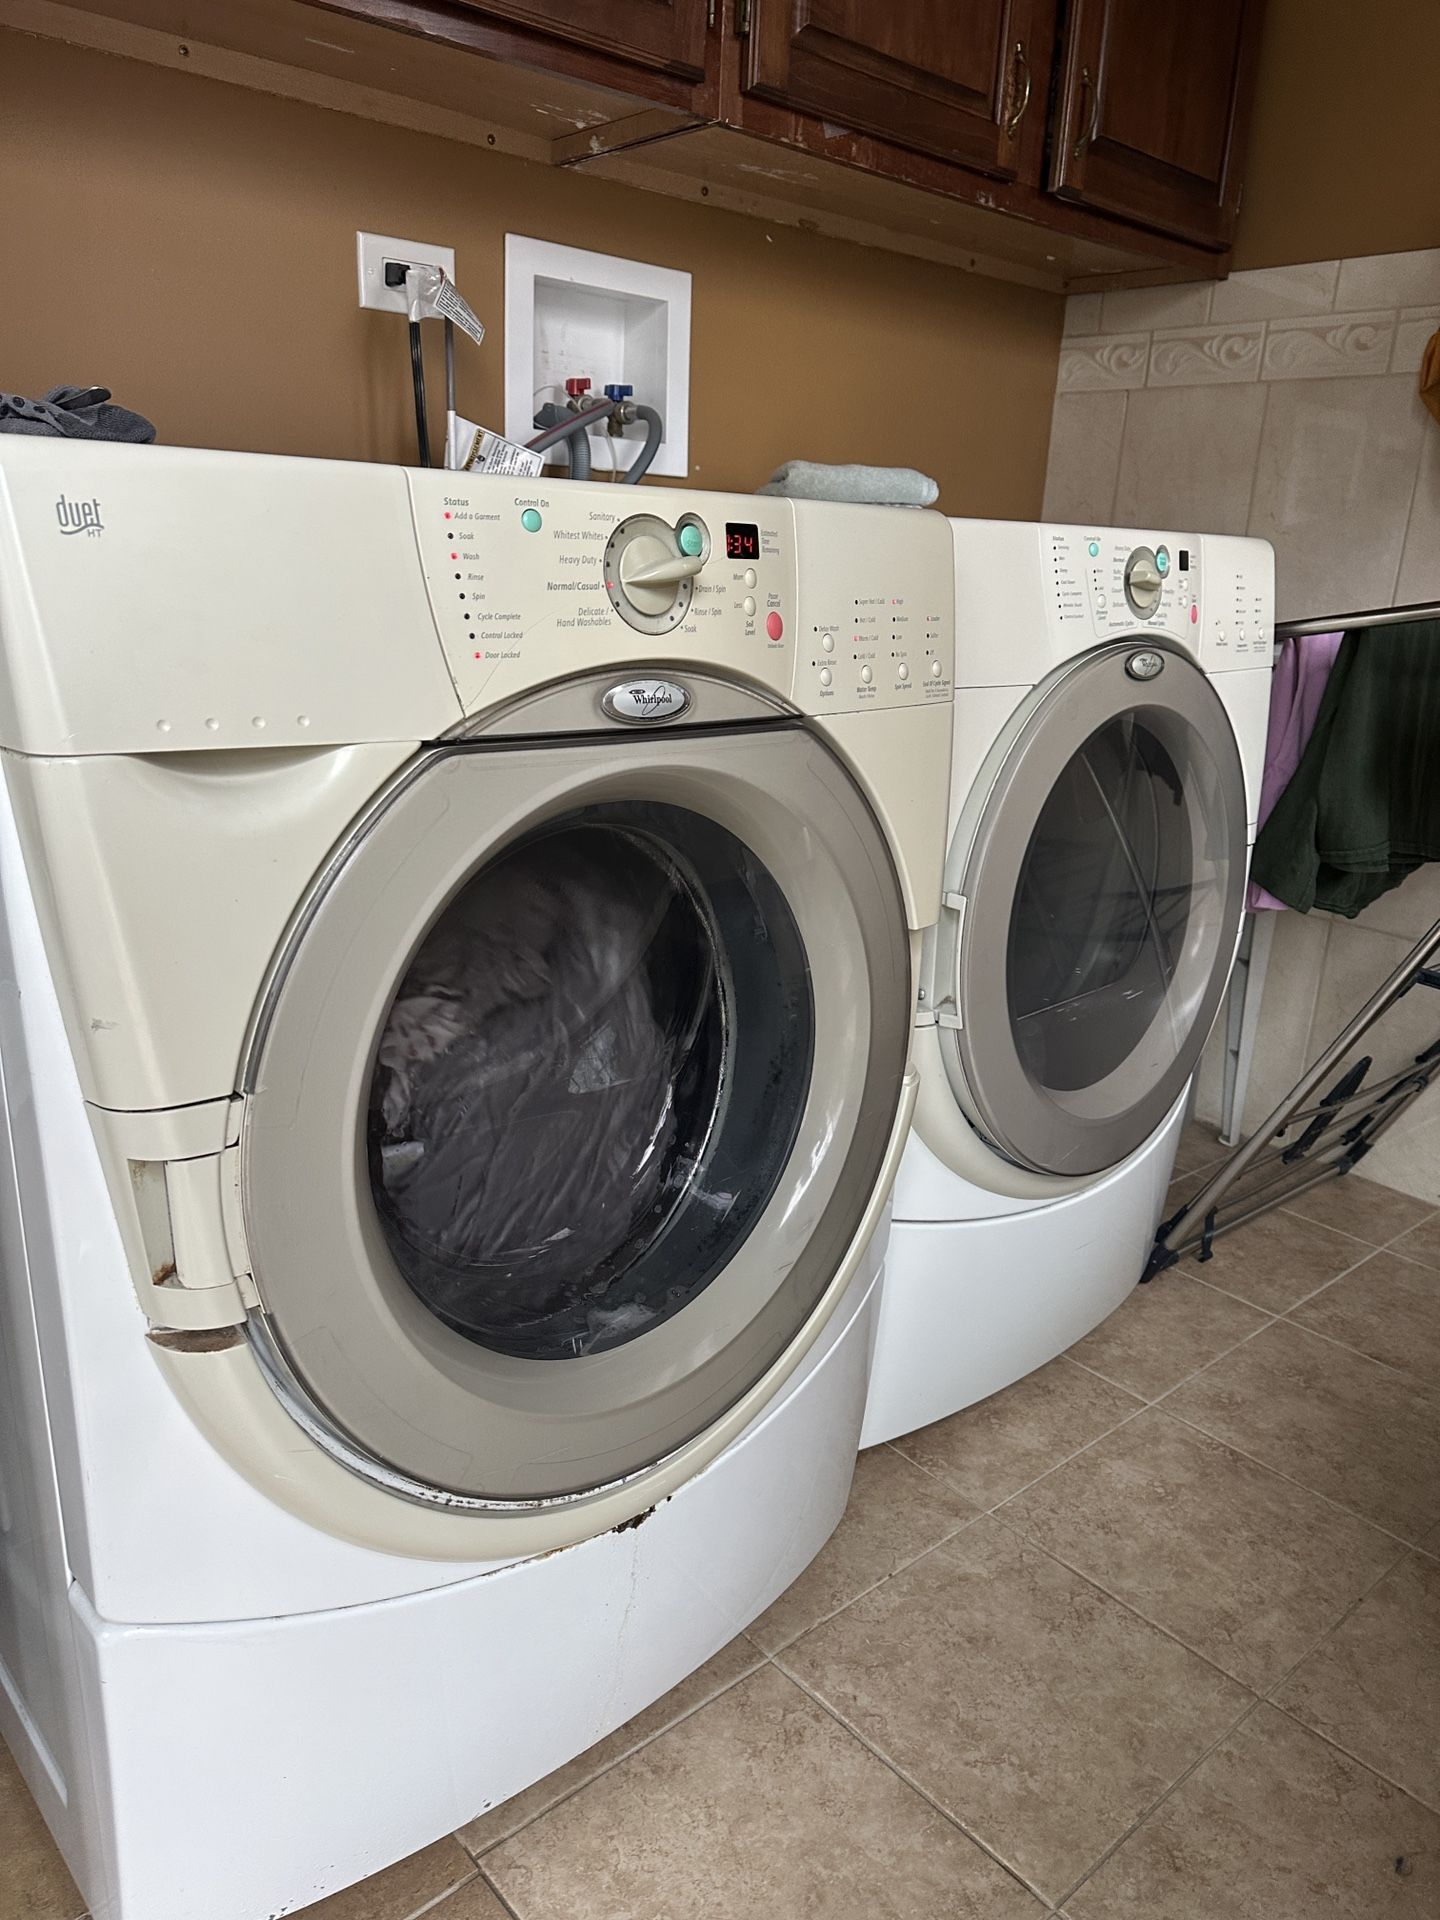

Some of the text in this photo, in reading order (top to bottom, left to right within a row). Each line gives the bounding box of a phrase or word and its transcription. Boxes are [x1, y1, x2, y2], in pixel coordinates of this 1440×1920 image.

[444, 497, 470, 506] Status
[514, 498, 538, 506] Control
[56, 494, 100, 527] duet
[589, 512, 616, 523] Sanitary
[87, 528, 101, 537] HT
[554, 530, 604, 540] Whitest Whites
[559, 555, 597, 565] Heavy Duty
[547, 582, 600, 590] Normal/Casual
[716, 584, 726, 594] Spin
[472, 592, 485, 600] Spin
[478, 612, 493, 621] Cycle
[578, 608, 604, 616] Delicate
[712, 608, 722, 617] Spin
[557, 618, 611, 627] Hand Washables
[633, 694, 672, 706] Whirlpool
